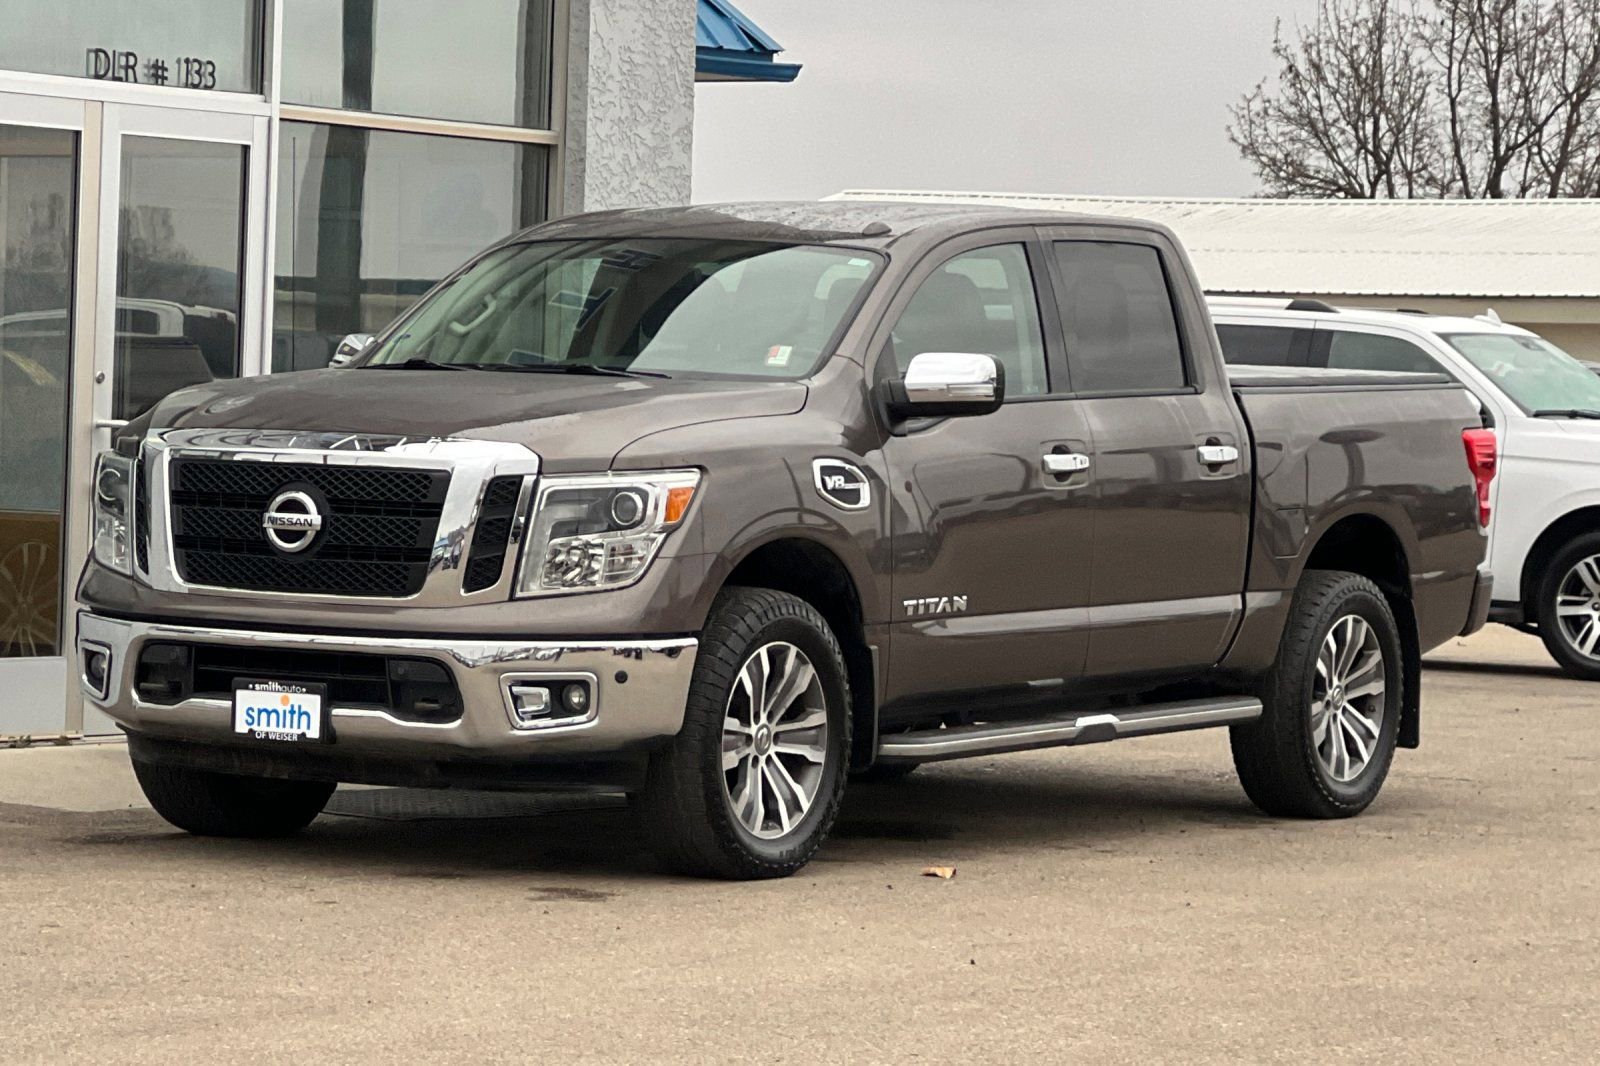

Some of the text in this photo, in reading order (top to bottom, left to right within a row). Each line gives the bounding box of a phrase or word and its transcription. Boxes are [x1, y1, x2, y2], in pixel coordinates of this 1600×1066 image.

[94, 47, 138, 83] DLR
[151, 58, 169, 86] #
[822, 475, 845, 490] V8
[266, 516, 313, 527] NISSAN
[903, 595, 968, 616] TITAN
[245, 695, 311, 731] smith
[255, 731, 298, 741] OF WEISER
